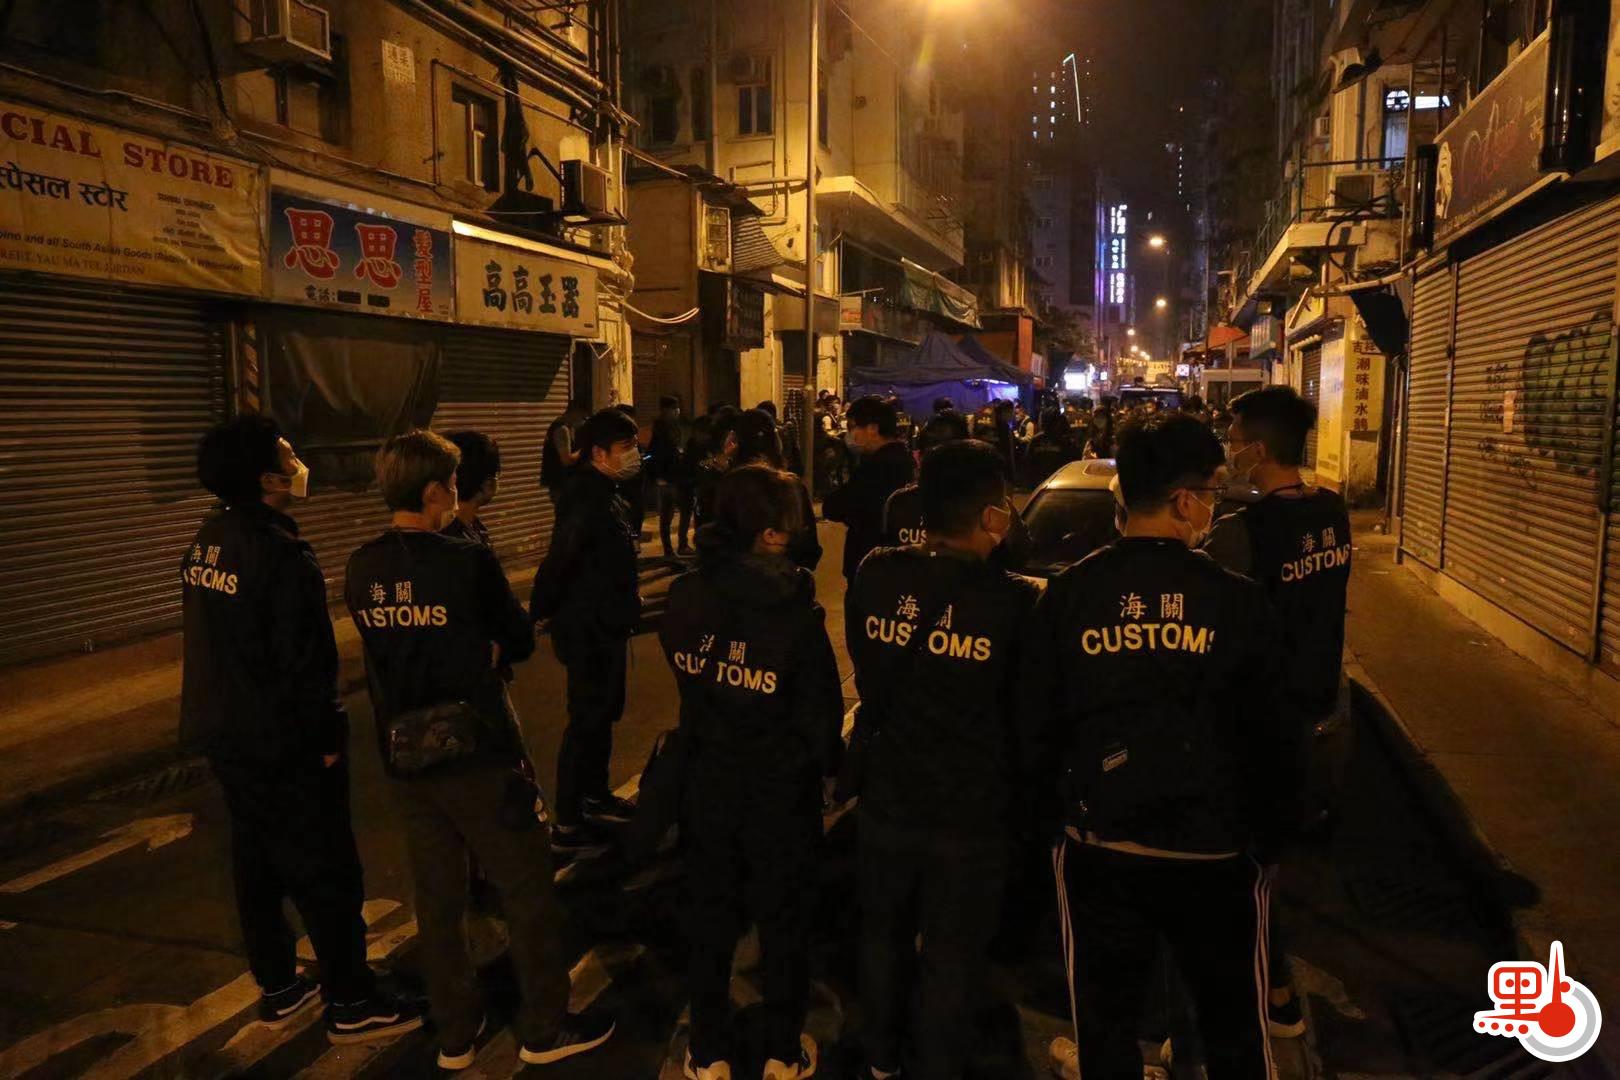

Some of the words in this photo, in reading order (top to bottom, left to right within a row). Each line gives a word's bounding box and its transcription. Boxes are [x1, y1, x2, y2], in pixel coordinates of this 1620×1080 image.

[1, 112, 101, 158] CIAL
[123, 142, 233, 189] STORE
[284, 207, 402, 288] 思思
[482, 259, 579, 318] 高高玉器
[369, 581, 412, 604] 海關
[1119, 592, 1185, 621] 海關
[865, 615, 992, 662] CUSOMS
